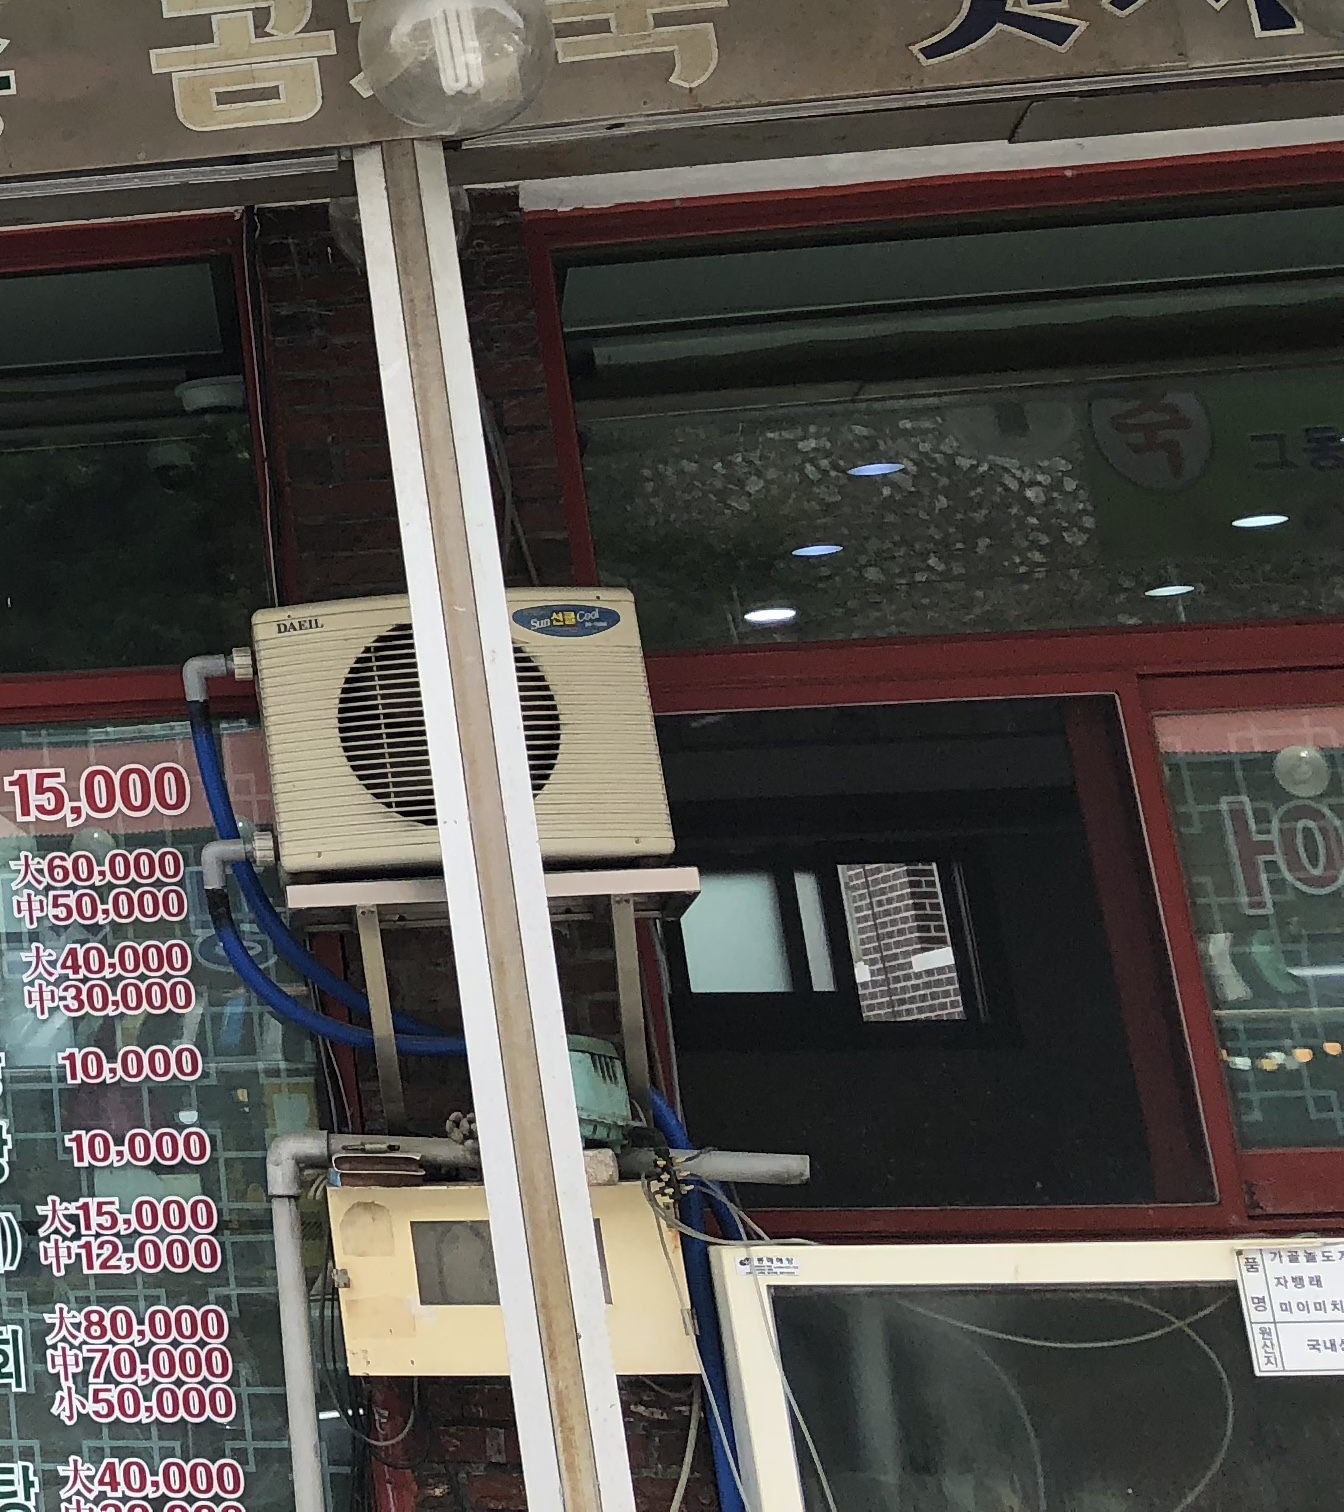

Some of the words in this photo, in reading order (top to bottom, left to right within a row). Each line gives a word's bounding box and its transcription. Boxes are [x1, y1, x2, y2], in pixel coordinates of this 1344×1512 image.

[275, 618, 325, 635] DAEIL
[5, 762, 192, 829] 15,000
[58, 1044, 204, 1086] 10,000
[64, 1127, 212, 1169] 10,000
